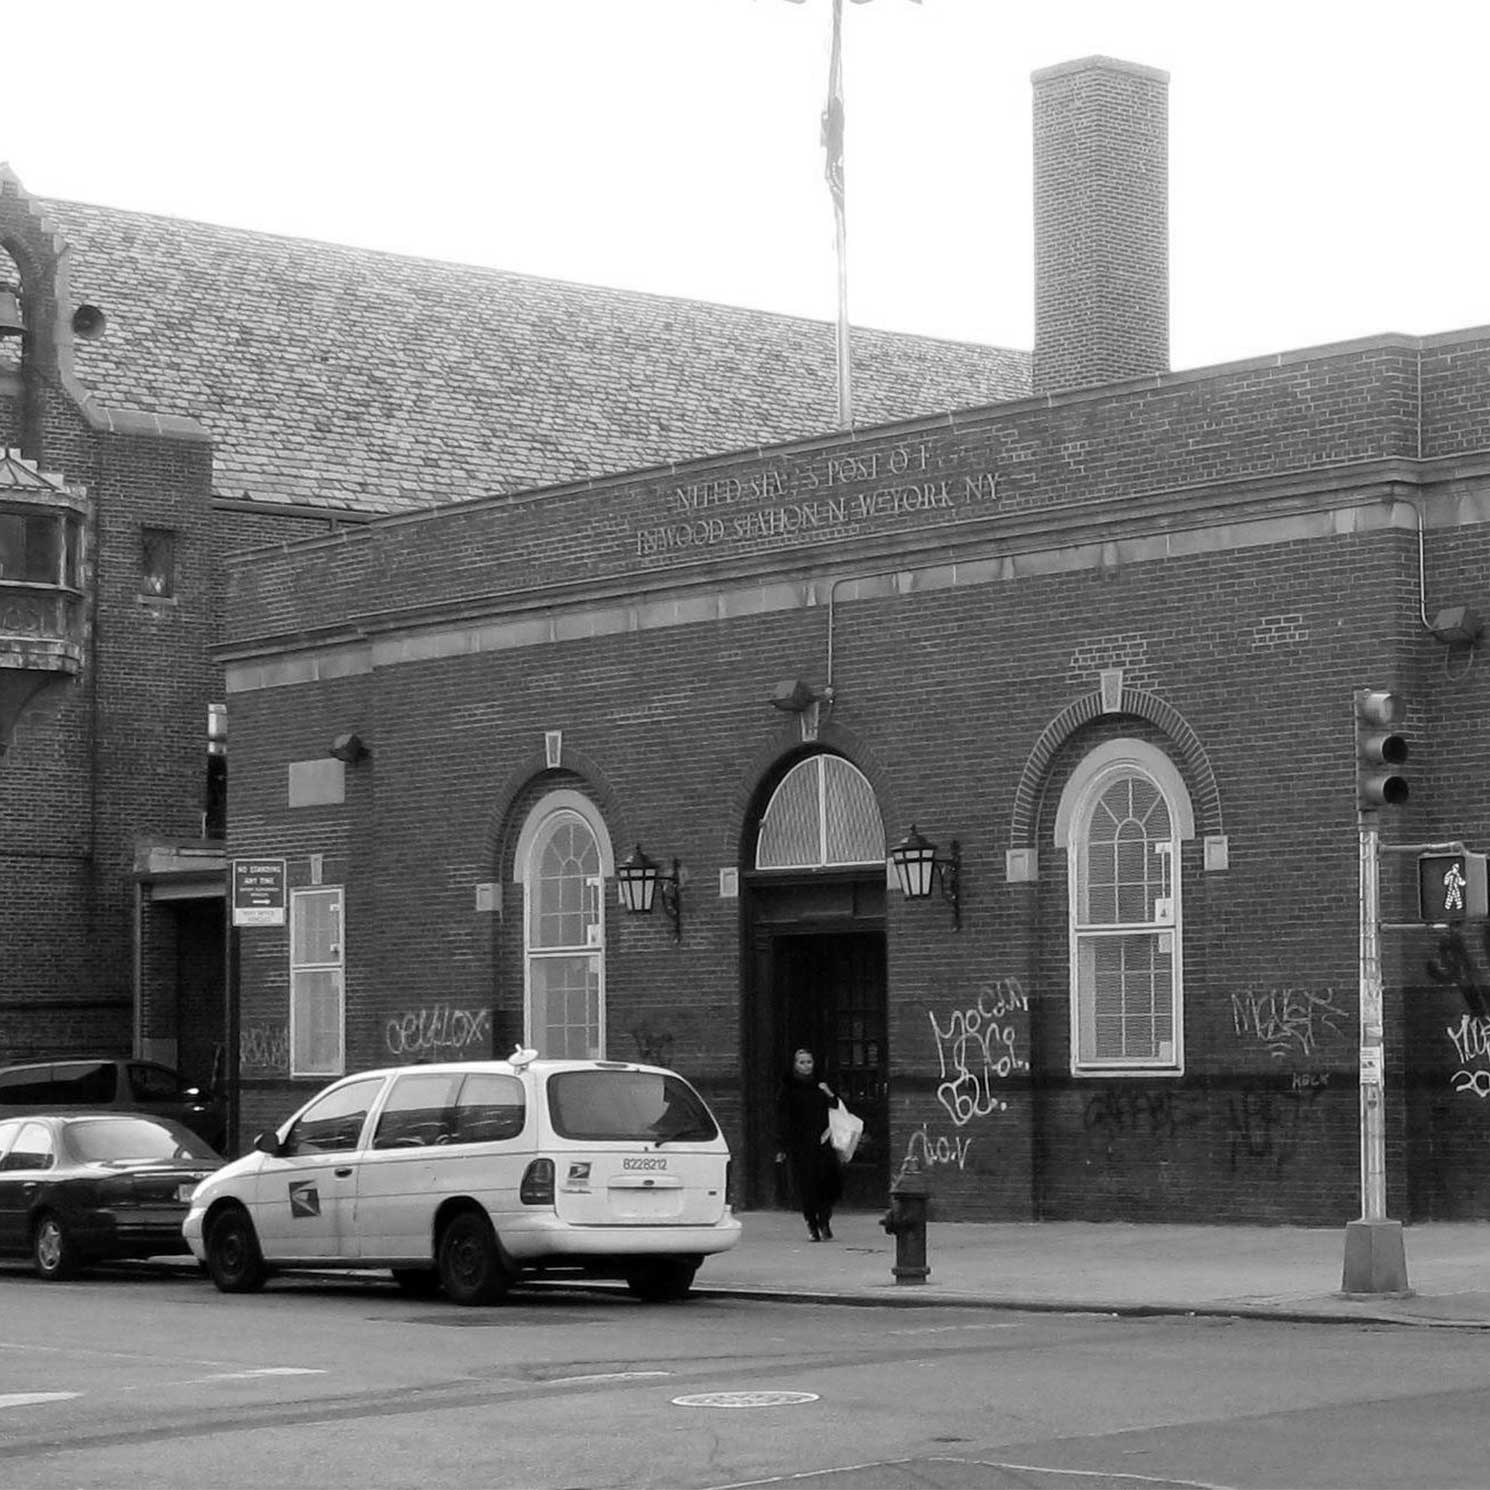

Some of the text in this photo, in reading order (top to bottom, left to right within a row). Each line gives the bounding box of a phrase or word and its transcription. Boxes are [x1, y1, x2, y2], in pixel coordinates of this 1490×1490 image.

[828, 454, 881, 486] POST
[733, 501, 818, 537] STATION
[887, 481, 954, 513] YORK
[965, 472, 999, 503] NY
[622, 1158, 667, 1170] 8228212
